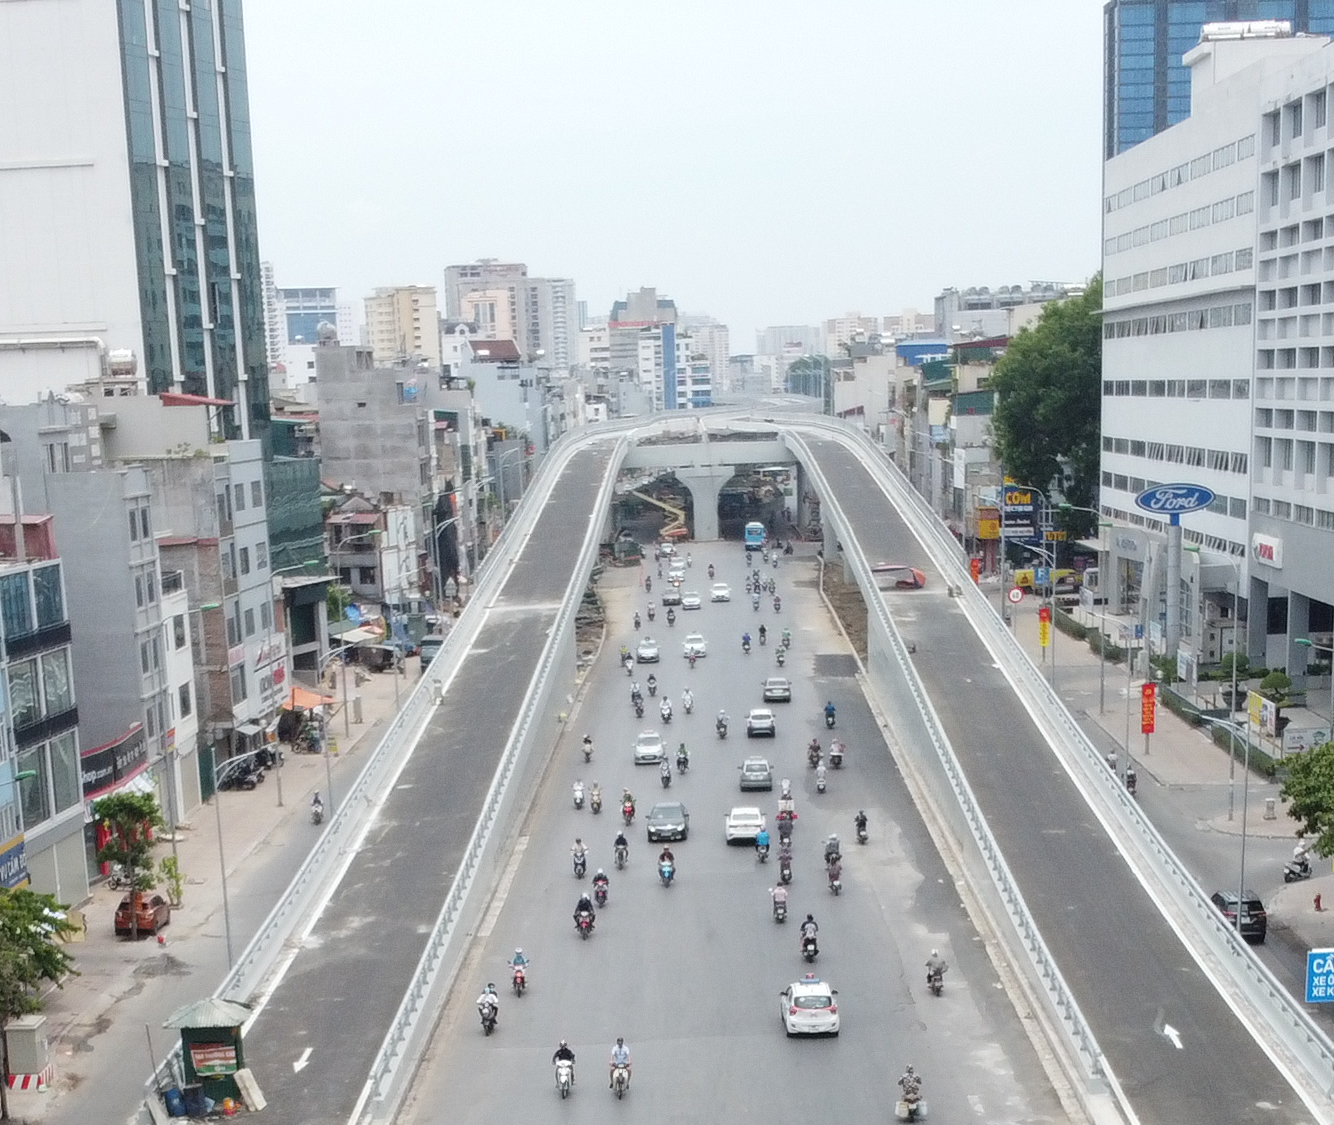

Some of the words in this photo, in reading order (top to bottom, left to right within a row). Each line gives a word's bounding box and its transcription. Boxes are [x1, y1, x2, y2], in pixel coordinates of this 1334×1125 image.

[1150, 488, 1198, 509] Ford
[1313, 976, 1326, 986] XE
[1328, 974, 1334, 985] Ô
[1312, 987, 1325, 997] XE
